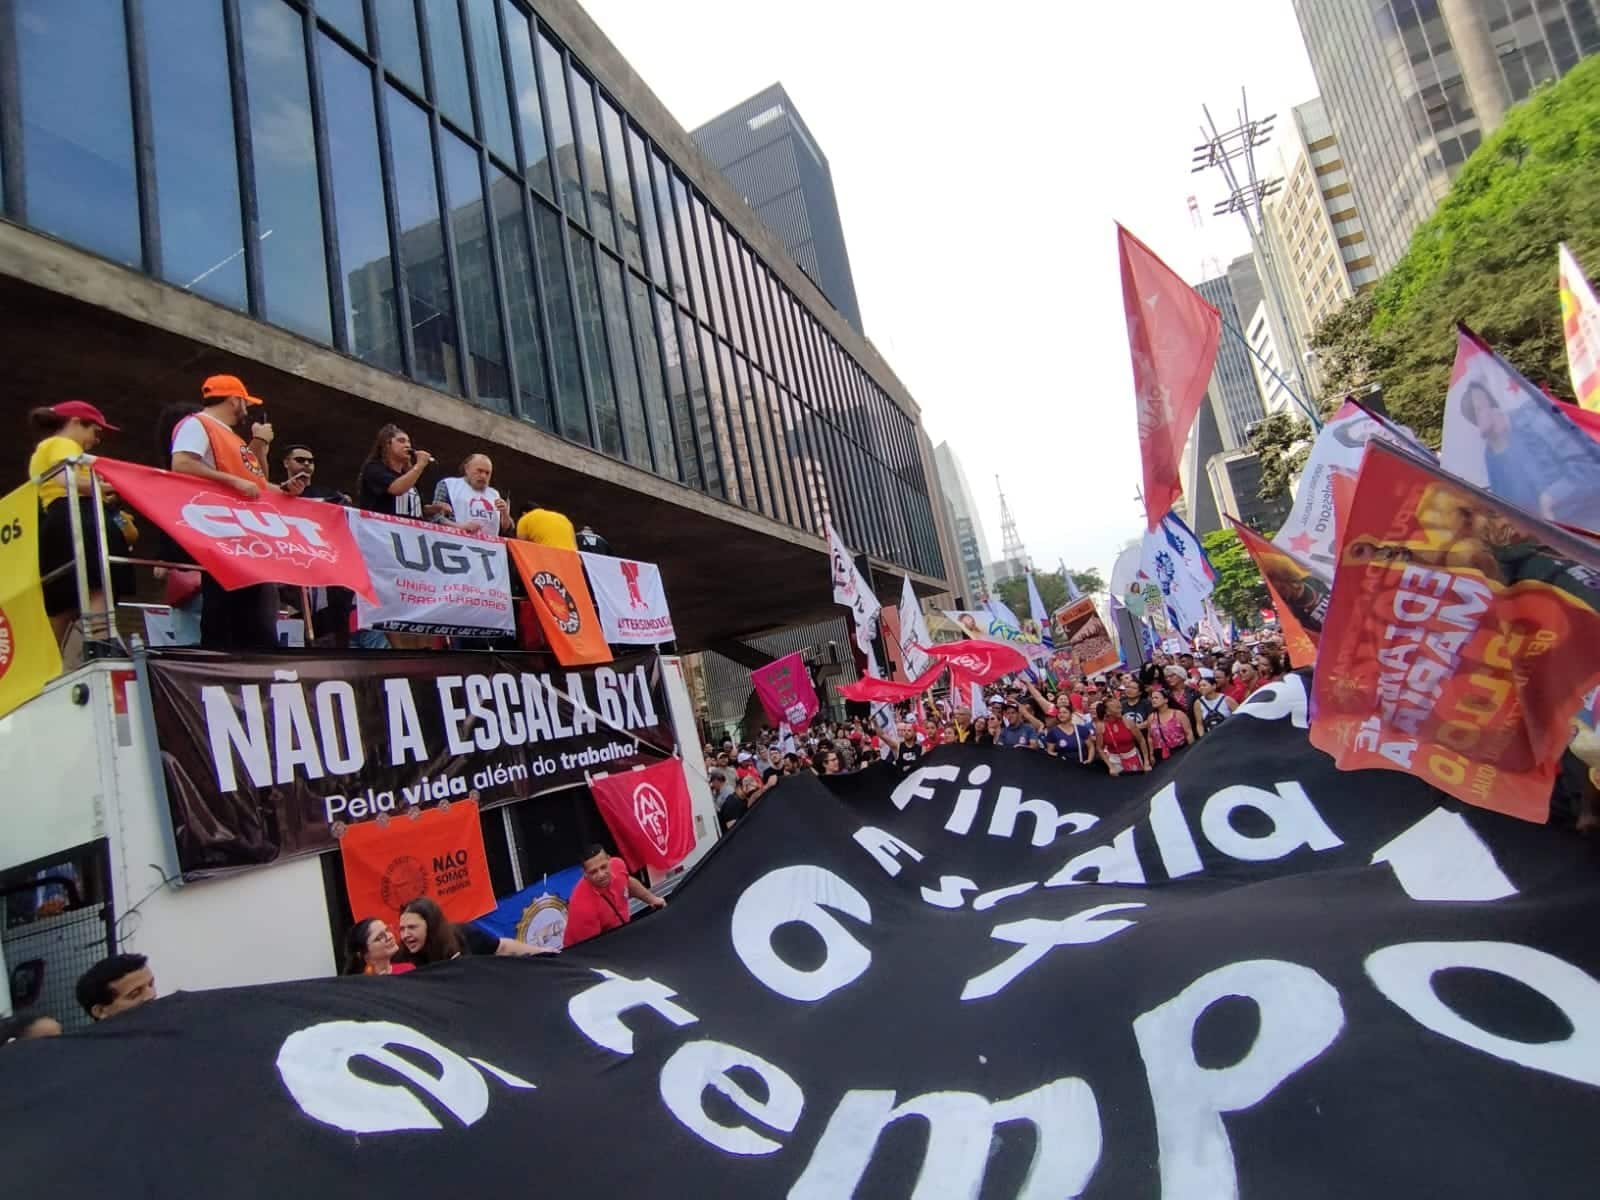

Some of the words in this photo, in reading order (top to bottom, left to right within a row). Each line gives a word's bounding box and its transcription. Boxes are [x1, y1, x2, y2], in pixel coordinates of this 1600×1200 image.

[182, 504, 331, 548] CUT
[470, 509, 493, 520] UGT
[216, 539, 272, 558] SÃO
[390, 532, 497, 582] UGT
[201, 670, 364, 793] NÃO
[384, 678, 429, 766] A
[436, 672, 596, 756] ESCALA
[324, 788, 396, 823] Pela
[402, 772, 468, 805] vida
[473, 762, 528, 791] além
[532, 755, 556, 777] do
[560, 738, 640, 770] trabalho!
[890, 763, 1099, 846] Fim
